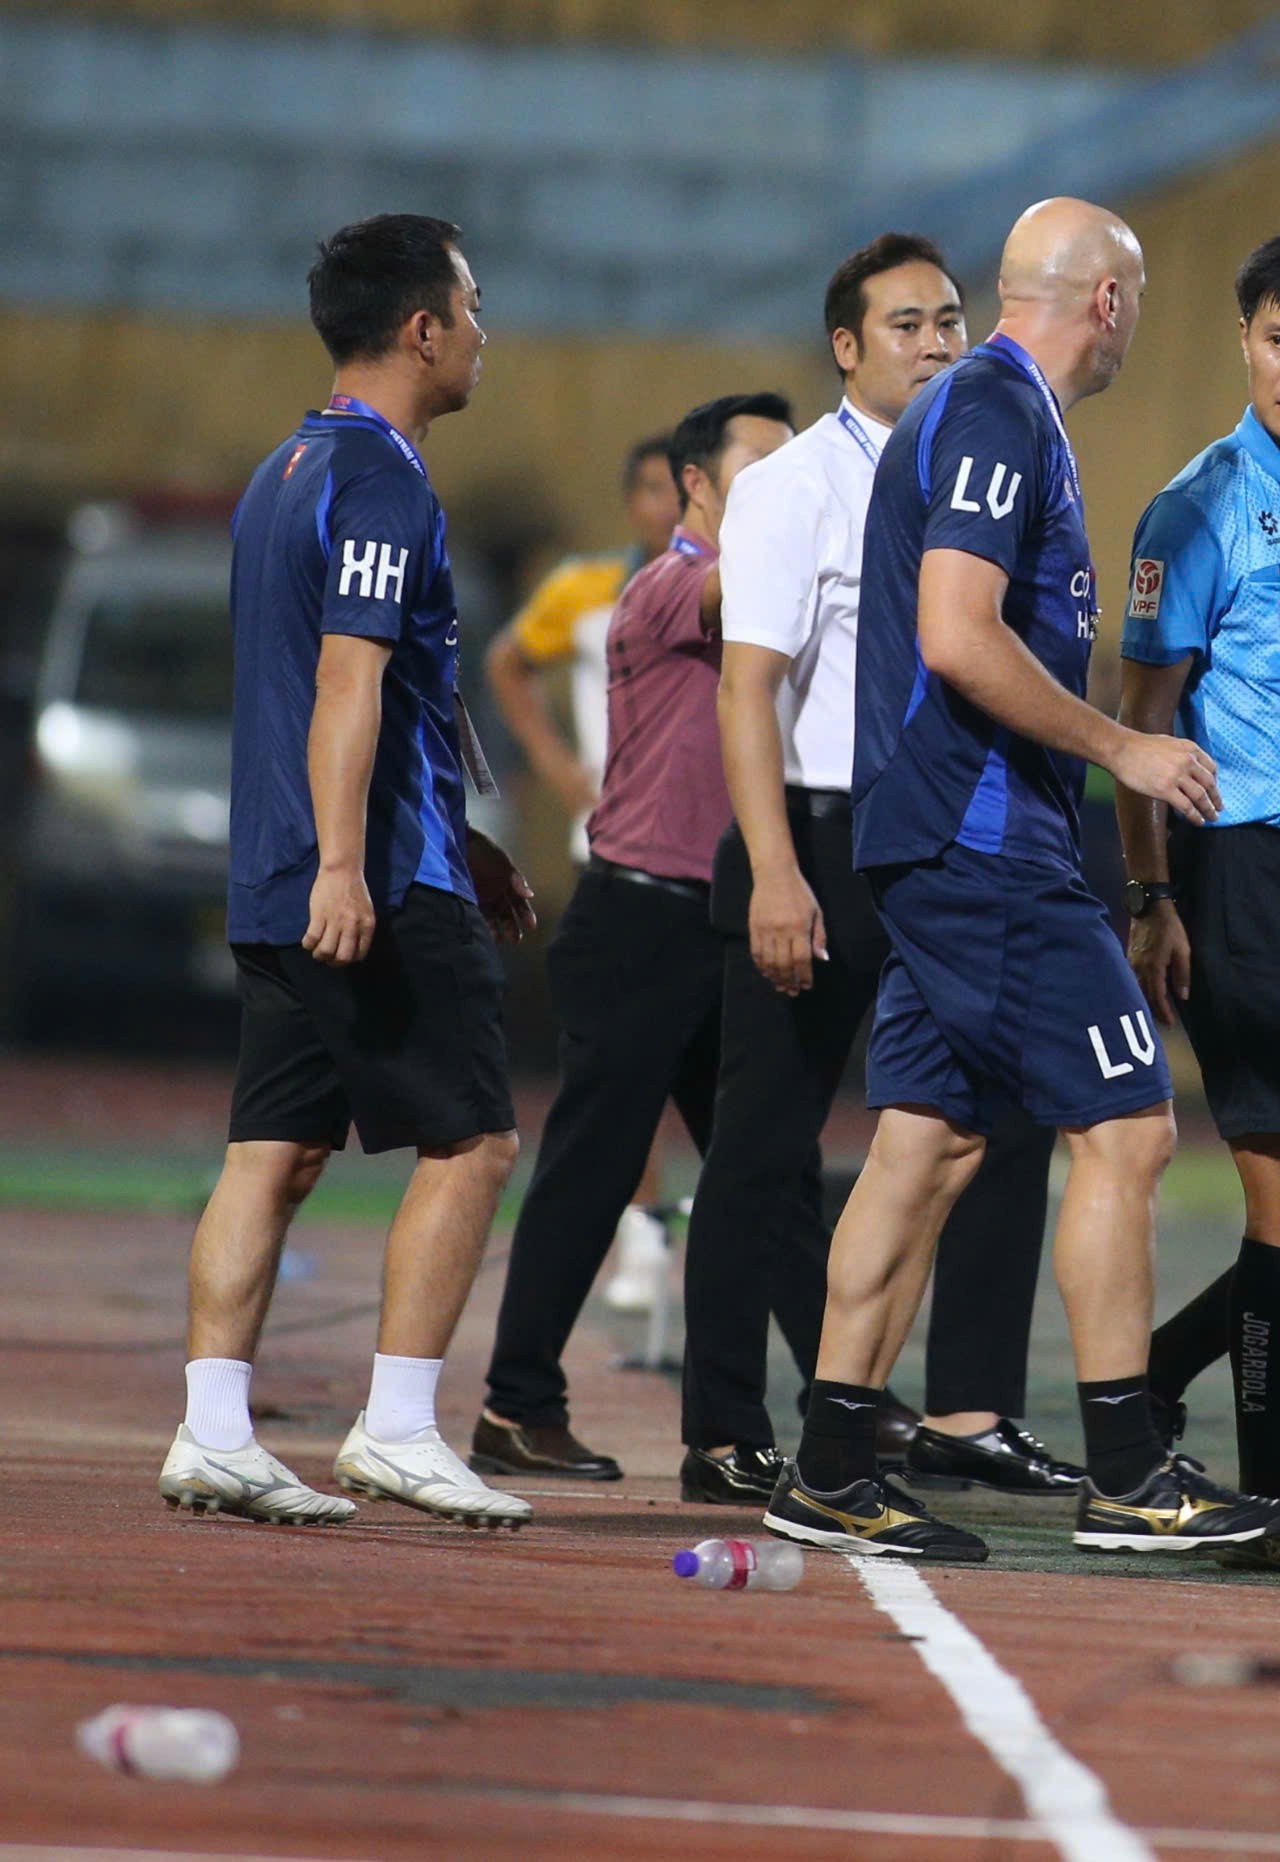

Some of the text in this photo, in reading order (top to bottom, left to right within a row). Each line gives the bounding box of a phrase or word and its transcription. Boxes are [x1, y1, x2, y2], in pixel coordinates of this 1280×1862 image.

[1029, 363, 1052, 401] FOOTBALL
[389, 428, 415, 461] VIETNAM
[950, 456, 1022, 520] LV
[338, 539, 409, 604] XH
[1133, 600, 1157, 613] VPF
[1087, 1010, 1155, 1079] LV
[1242, 1311, 1271, 1412] JOGARBOLA
